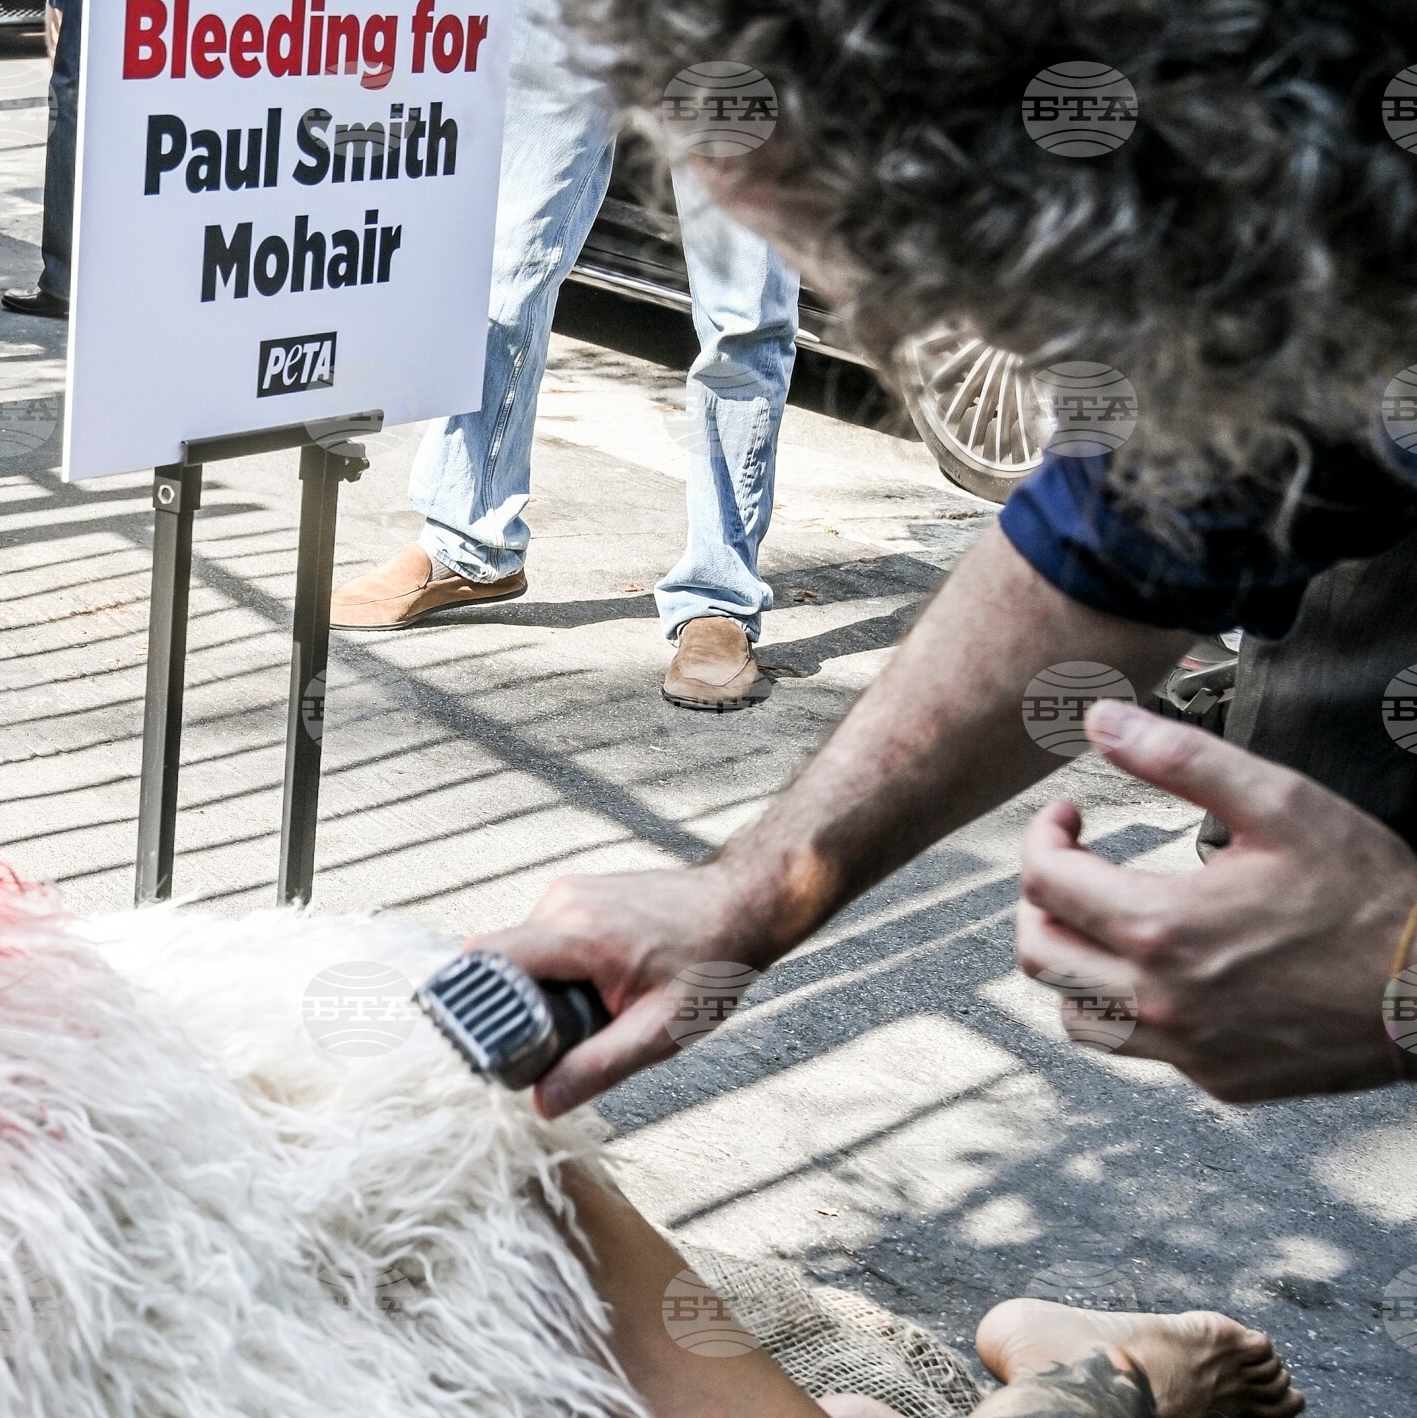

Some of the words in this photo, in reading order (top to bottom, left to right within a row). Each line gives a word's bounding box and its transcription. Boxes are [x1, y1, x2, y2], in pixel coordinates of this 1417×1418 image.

[143, 107, 282, 196] Paul
[292, 101, 459, 186] Smith
[200, 208, 403, 303] Mohair
